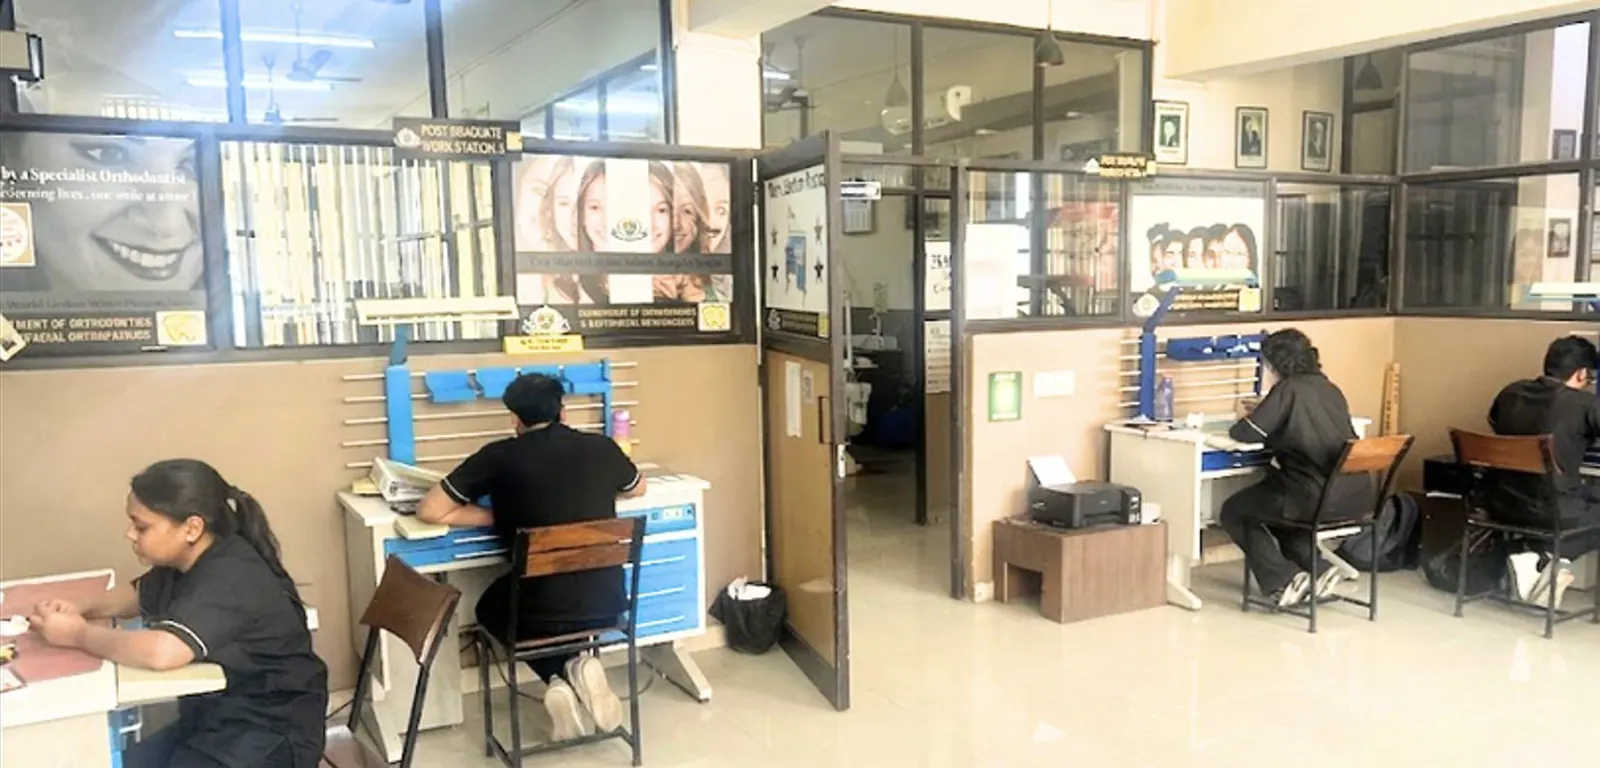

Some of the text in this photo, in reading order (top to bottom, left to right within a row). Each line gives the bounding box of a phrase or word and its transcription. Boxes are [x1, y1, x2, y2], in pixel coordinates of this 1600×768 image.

[421, 124, 448, 137] POST
[20, 170, 29, 181] a
[30, 167, 99, 184] Specialist
[100, 169, 187, 185] Orthodontist
[51, 318, 67, 330] OF
